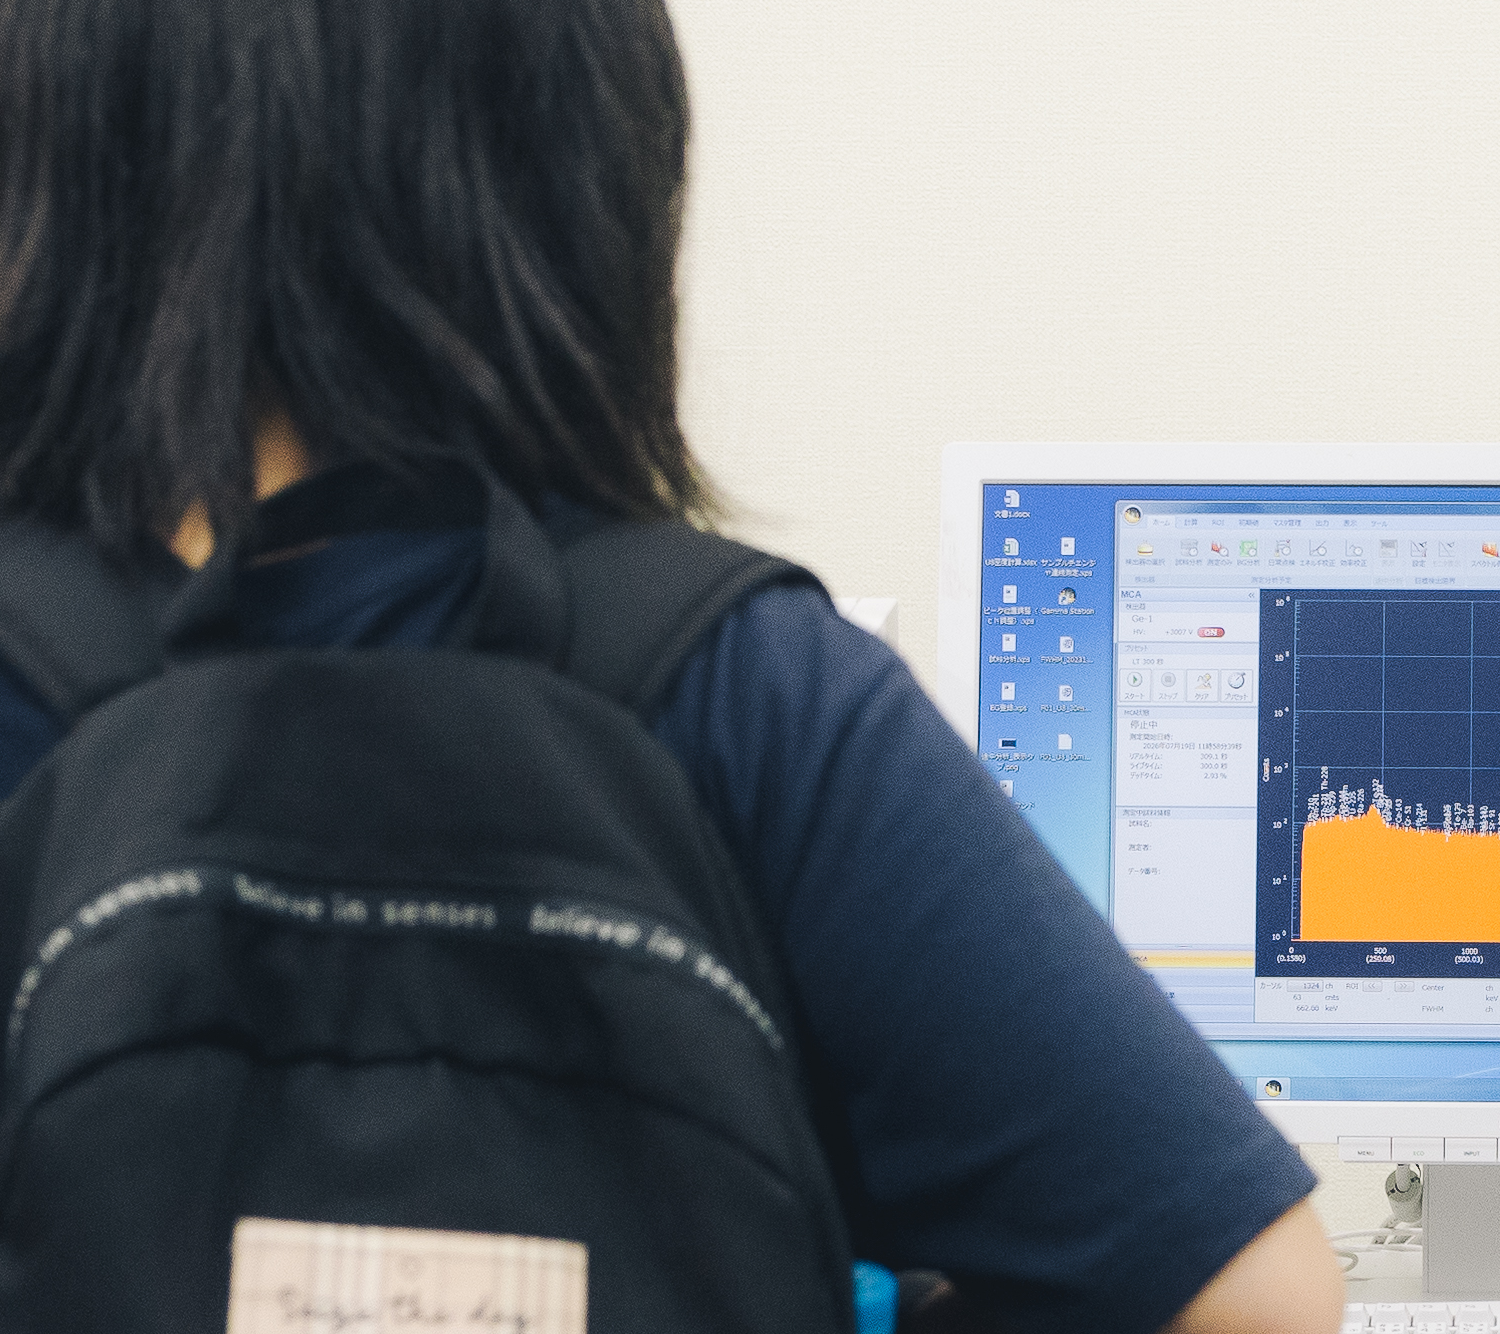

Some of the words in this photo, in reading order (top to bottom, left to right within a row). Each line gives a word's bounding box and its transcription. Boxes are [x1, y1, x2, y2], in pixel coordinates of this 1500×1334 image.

[1120, 590, 1142, 599] MCA
[1131, 614, 1153, 623] Ge-1
[1204, 628, 1218, 636] ON
[1130, 719, 1158, 730] 停止中
[1142, 742, 1196, 750] 2026年07月19日
[1199, 762, 1219, 770] 300.0
[1302, 982, 1320, 990] 1324
[1421, 984, 1445, 992] Center
[1324, 1004, 1339, 1012] keV
[1421, 1005, 1444, 1013] FWHM
